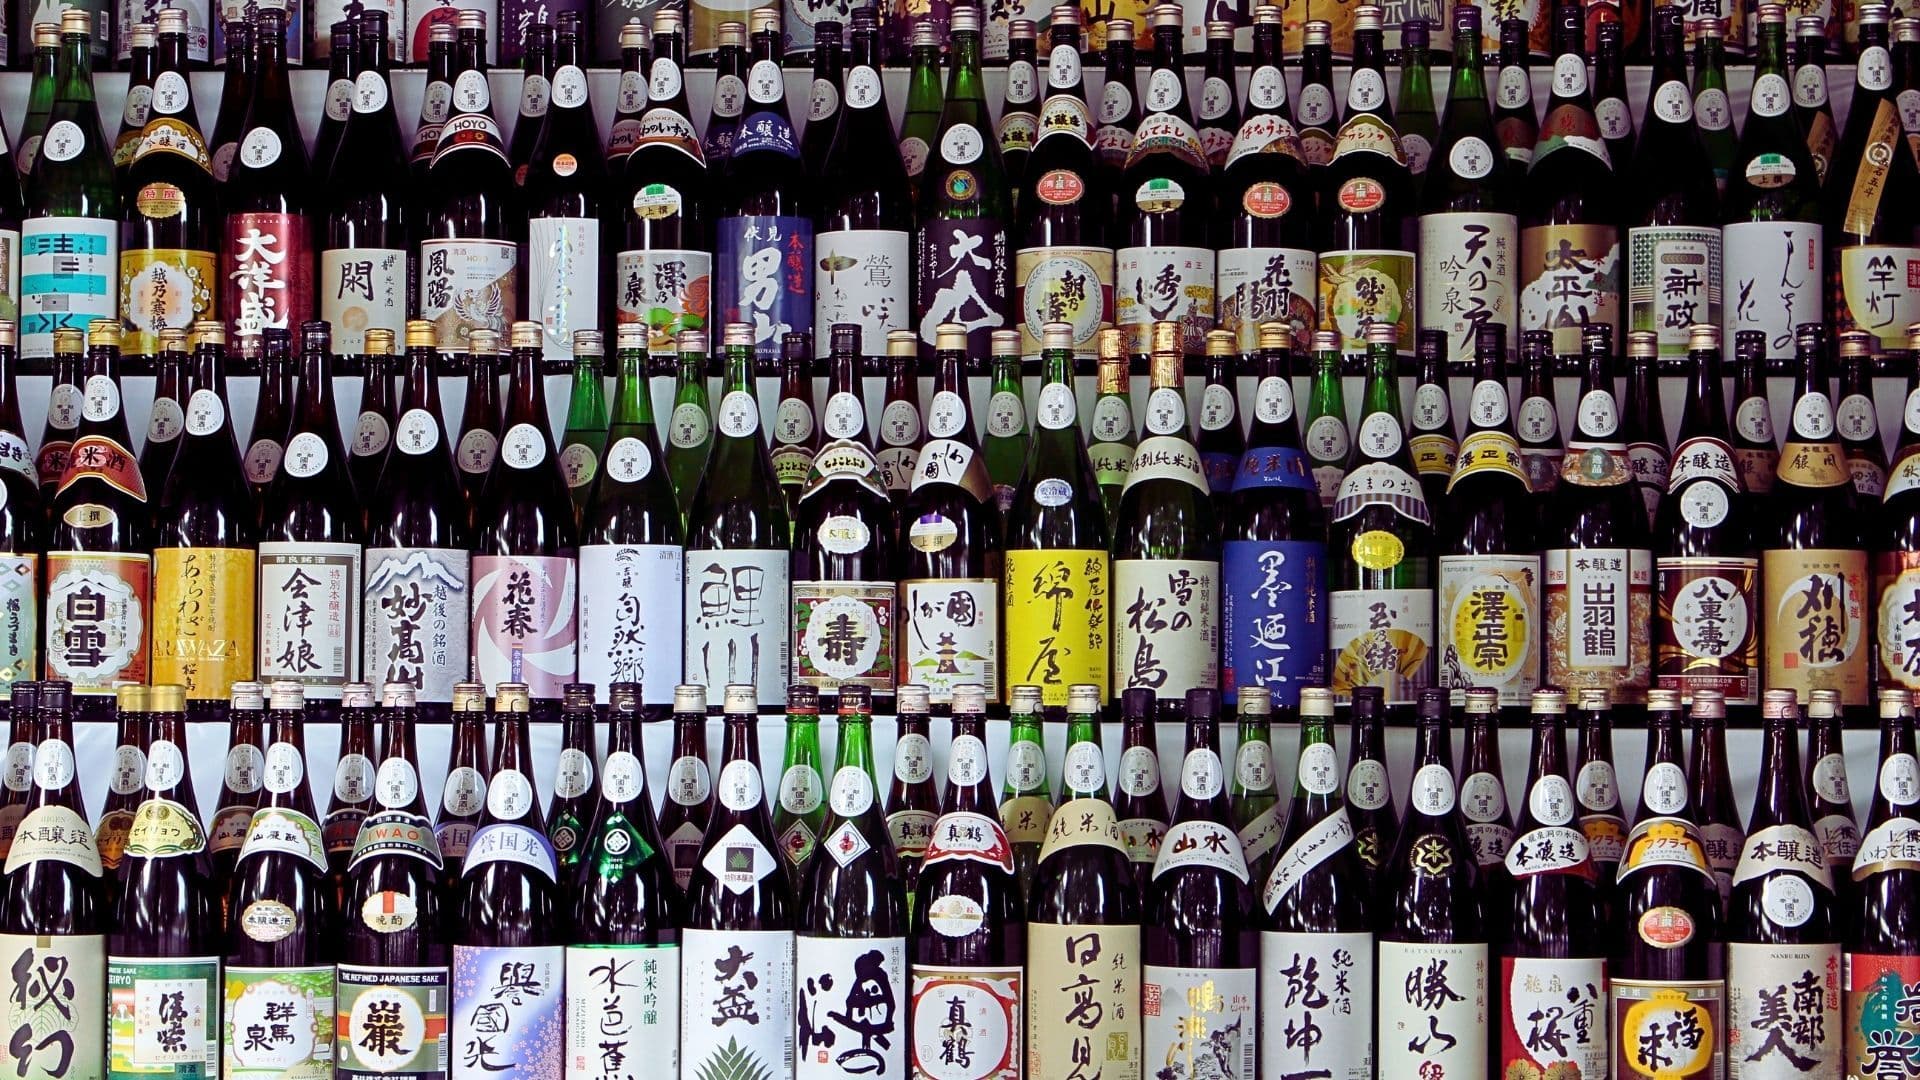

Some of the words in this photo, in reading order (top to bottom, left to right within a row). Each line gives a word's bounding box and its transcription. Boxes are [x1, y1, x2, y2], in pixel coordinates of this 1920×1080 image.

[454, 118, 487, 131] HOYO
[739, 120, 793, 146] 本醸造
[744, 226, 782, 242] 伏見
[787, 231, 804, 294] 本醸造
[994, 230, 1006, 298] 特別純米酒
[151, 268, 167, 331] 越乃寒梅
[229, 229, 289, 336] 大洋盛
[427, 249, 455, 308] 鳳陽
[624, 272, 647, 308] 泉
[738, 247, 792, 344] 男山
[920, 229, 1004, 346] 大山
[1439, 255, 1465, 314] 吟泉
[1662, 268, 1703, 330] 新政
[1867, 255, 1902, 328] 竿灯
[1130, 451, 1200, 474] 特別純米酒
[1350, 479, 1413, 493] たまのお
[1675, 454, 1731, 473] 本醸造
[328, 568, 340, 622] 特別本醸造
[1575, 557, 1622, 572] 本醸造
[276, 567, 322, 674] 会津娘
[432, 584, 448, 666] 越後の銘酒
[501, 571, 538, 639] 花春
[1026, 560, 1074, 685] 綿屋
[1168, 570, 1199, 631] 雪の
[1469, 590, 1509, 670] 澤正宗
[1582, 582, 1616, 656] 出羽鶴
[381, 582, 433, 690] 妙高山
[1126, 587, 1168, 688] 松島
[16, 826, 91, 850] 本醸造
[368, 827, 420, 843] IWAO
[480, 832, 538, 857] 誉国光
[946, 822, 985, 843] 真鶴
[1052, 813, 1119, 843] 純米酒
[1172, 832, 1230, 855] 山水
[1516, 841, 1580, 867] 本醸造
[1644, 838, 1691, 850] フクライ
[1751, 840, 1824, 869] 本醸造
[350, 974, 378, 983] REFINED
[379, 975, 421, 984] JAPANESE
[422, 975, 439, 984] SAKE
[643, 959, 658, 1025] 純米吟醸
[1061, 933, 1103, 1080] 日高見
[1111, 953, 1127, 1020] 純米酒
[1332, 949, 1354, 1015] 純米酒
[1405, 957, 1466, 1054] 勝山
[1826, 954, 1838, 1011] 本醸造
[9, 947, 75, 1078] 秘幻
[939, 996, 975, 1068] 真鶴
[1280, 953, 1332, 1080] 乾坤一
